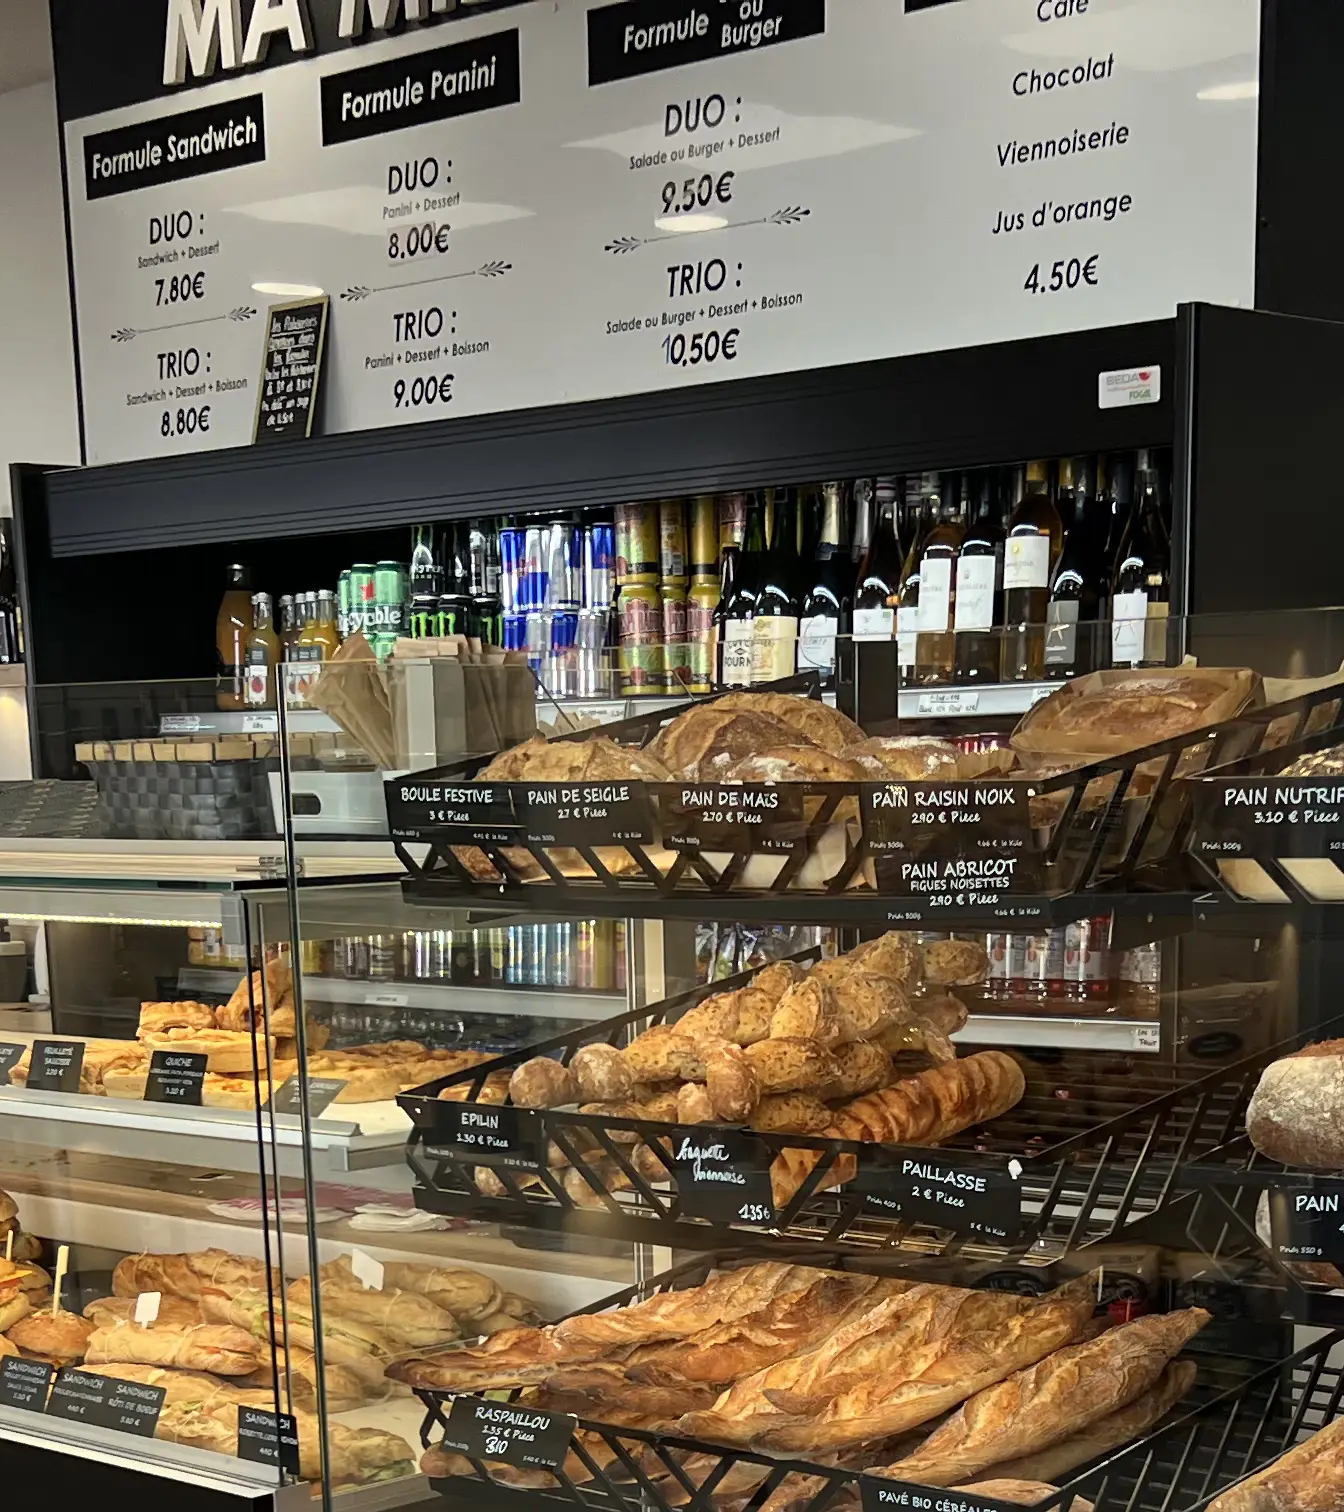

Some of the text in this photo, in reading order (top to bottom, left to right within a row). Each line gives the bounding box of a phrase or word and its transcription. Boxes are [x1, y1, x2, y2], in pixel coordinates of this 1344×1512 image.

[624, 8, 709, 54] Formule
[721, 15, 783, 48] Burger
[342, 55, 496, 122] Formule Panini
[1012, 53, 1114, 96] Chocolat
[664, 94, 725, 137] DUO
[93, 116, 257, 179] Formule Sandwich
[629, 126, 780, 170] Salade ou Burger Dessert
[997, 121, 1129, 167] Viennoiserie
[388, 157, 439, 195] DUO
[662, 170, 735, 214] 9.50€
[383, 192, 460, 219] Panini Dessert
[992, 194, 1132, 234] Jus d'orange
[149, 210, 192, 244] DUO
[388, 224, 451, 259] 8.00€
[138, 241, 219, 268] Sandwich Dessert
[155, 271, 205, 306] 7.80€
[667, 258, 726, 297] TRIO
[1023, 253, 1100, 294] 4.50€
[393, 307, 443, 342] TRIO
[606, 292, 803, 335] Salade ou Burger Dessert Boisson
[157, 348, 199, 380] TRIO
[365, 341, 489, 370] Panini Dessert Boisson
[127, 378, 248, 405] Sandwich Dessert Boisson
[394, 374, 455, 408] 9.00€
[161, 406, 211, 436] 8.80€
[401, 787, 493, 804] BOULE FESTIVE
[528, 786, 629, 805] PAIN DE SEIGLE
[682, 790, 738, 807] PAIN DE
[872, 787, 1015, 809] PAIN RAISIN NOIX
[1224, 788, 1267, 806] PAIN
[1254, 810, 1283, 823] 3.10
[902, 857, 1017, 881] PAIN ABRICOT
[911, 876, 1009, 892] FIGUES NOISETTES
[461, 1112, 499, 1130] EPILIN
[903, 1160, 987, 1193] PAILLASSE
[1295, 1195, 1339, 1212] PAIN
[475, 1406, 550, 1431] RASPAILLOU
[878, 1489, 909, 1506] PAVÉ
[912, 1496, 932, 1510] BIO
